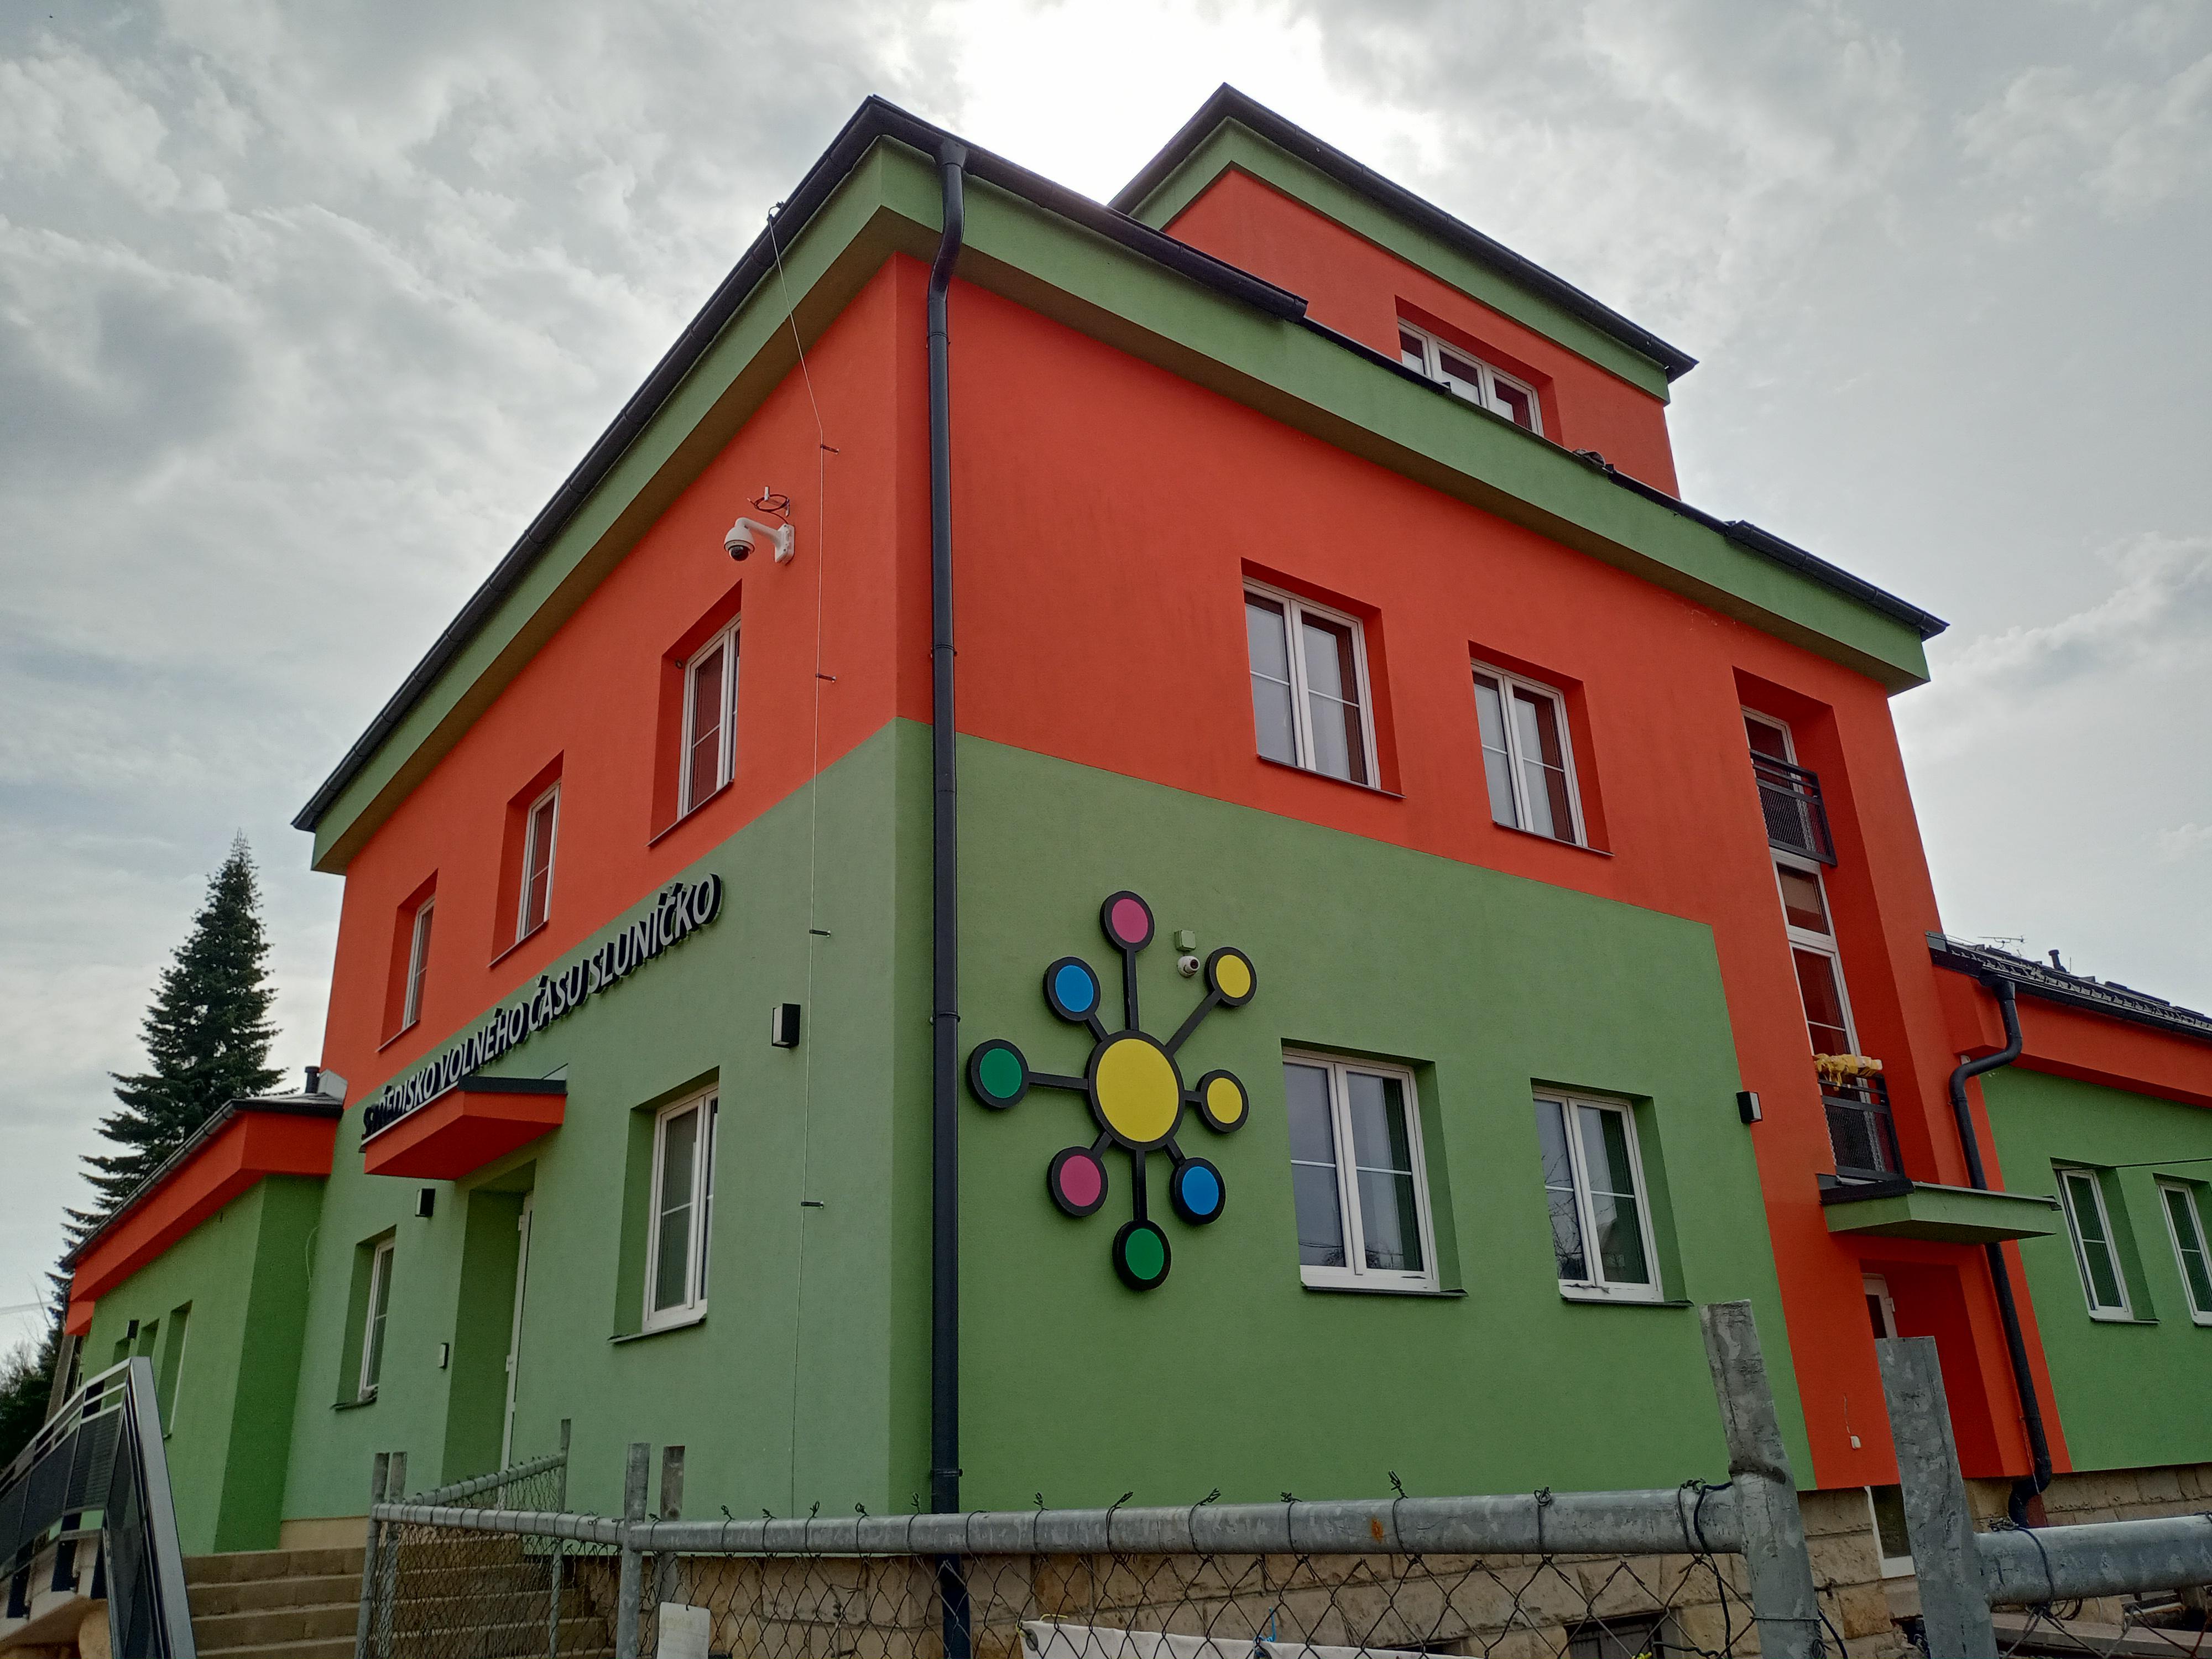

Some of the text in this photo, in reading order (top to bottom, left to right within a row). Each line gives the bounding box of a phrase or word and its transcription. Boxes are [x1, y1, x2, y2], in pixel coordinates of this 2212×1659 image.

[440, 1002, 529, 1088] VOLNÉHO
[528, 974, 589, 1031] ČASU
[588, 873, 722, 994] SLUNÍČKO
